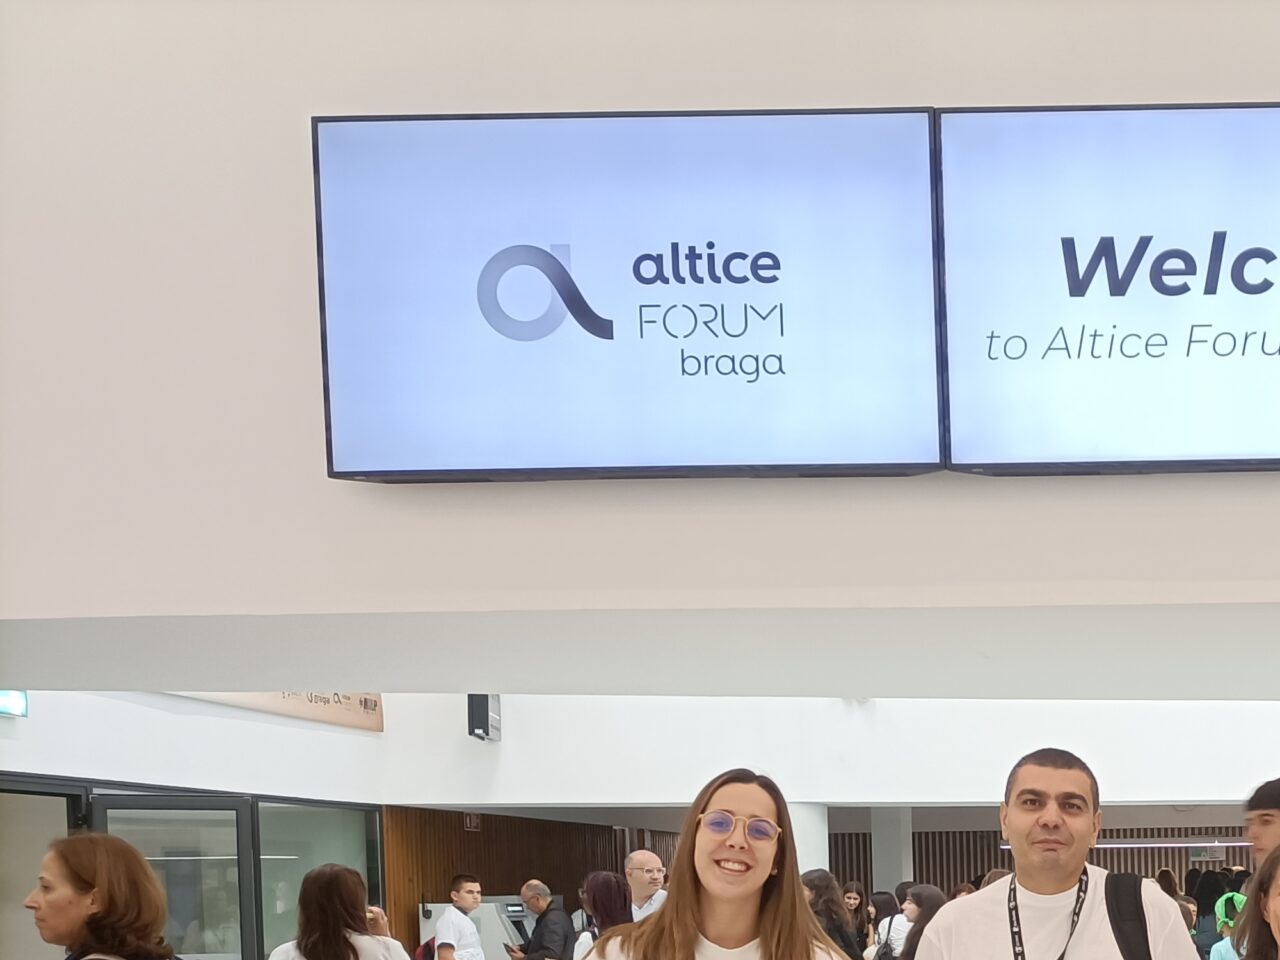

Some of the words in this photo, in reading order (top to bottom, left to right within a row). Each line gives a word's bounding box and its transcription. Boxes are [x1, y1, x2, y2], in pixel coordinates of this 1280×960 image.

[632, 240, 782, 286] altice
[638, 302, 785, 340] FORUM
[985, 329, 1028, 361] to
[1042, 323, 1169, 360] Altice
[680, 348, 786, 384] braga
